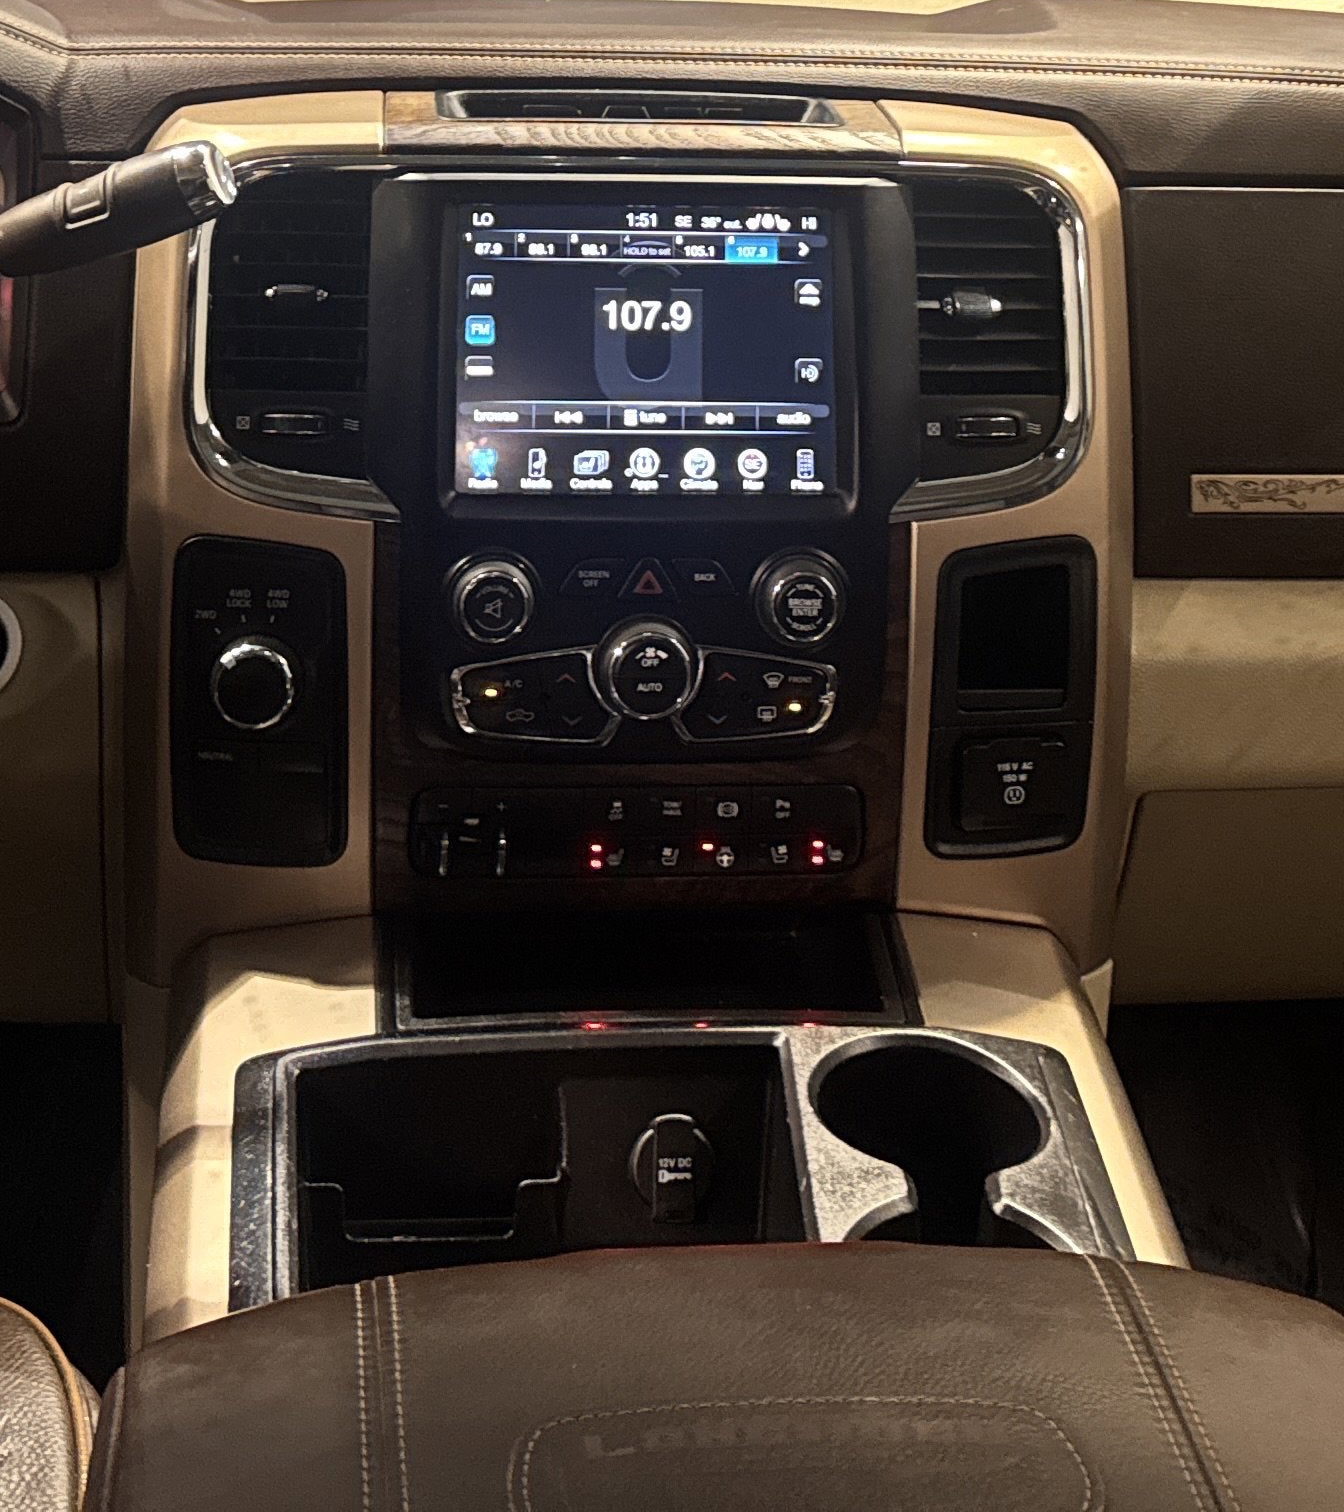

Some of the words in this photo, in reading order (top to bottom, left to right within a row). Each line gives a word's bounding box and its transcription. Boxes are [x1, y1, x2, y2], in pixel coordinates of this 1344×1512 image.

[471, 211, 496, 227] LO
[625, 212, 659, 228] 1:51
[674, 214, 694, 229] SE
[800, 216, 818, 230] HI
[623, 246, 648, 257] HOLD
[736, 246, 768, 258] 107.9
[470, 282, 494, 296] AM
[602, 299, 694, 332] 107.9
[470, 323, 491, 336] FM
[578, 569, 611, 579] SCREEN
[693, 572, 716, 583] BACK
[582, 579, 599, 588] OFF
[226, 599, 253, 608] LOCK
[266, 599, 290, 609] LOW
[636, 682, 663, 692] AUTO
[658, 1157, 676, 1168] 12V
[677, 1156, 693, 1168] DC
